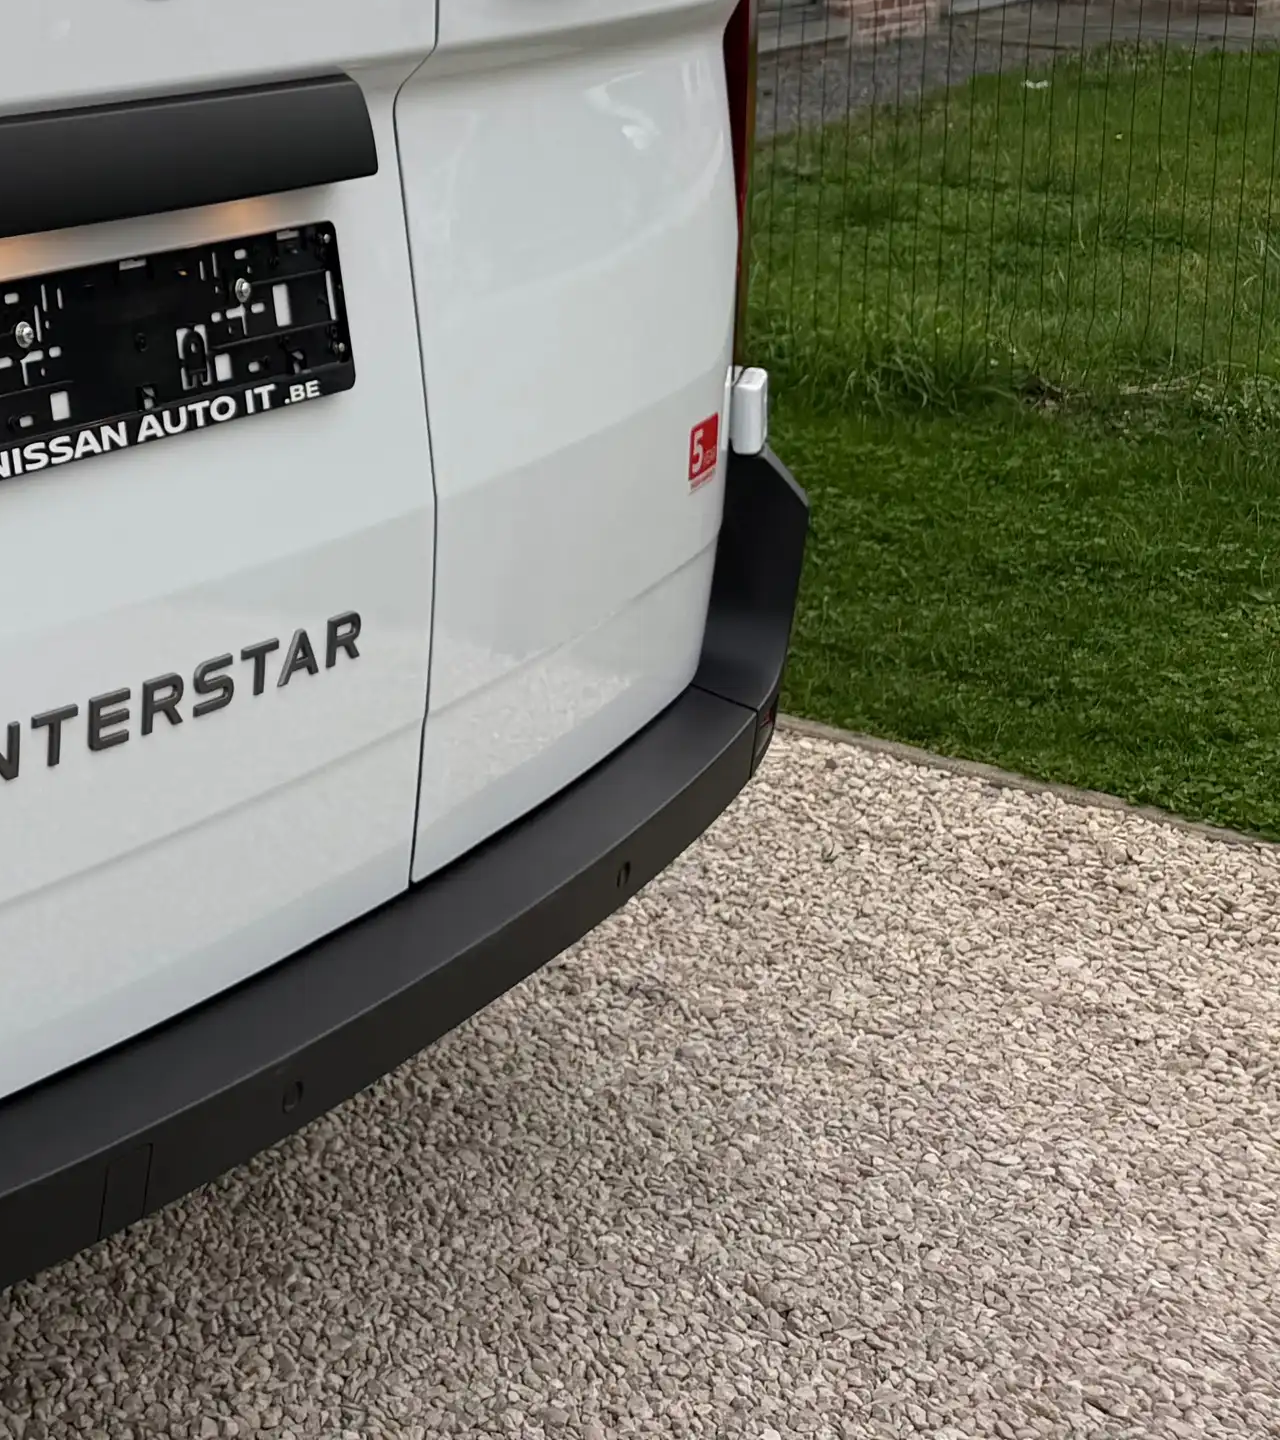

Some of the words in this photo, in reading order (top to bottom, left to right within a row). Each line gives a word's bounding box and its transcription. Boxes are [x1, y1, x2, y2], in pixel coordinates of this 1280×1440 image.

[137, 395, 237, 443] AUTO
[244, 383, 277, 414] IT
[283, 379, 321, 405] .BE
[692, 428, 704, 474] 5
